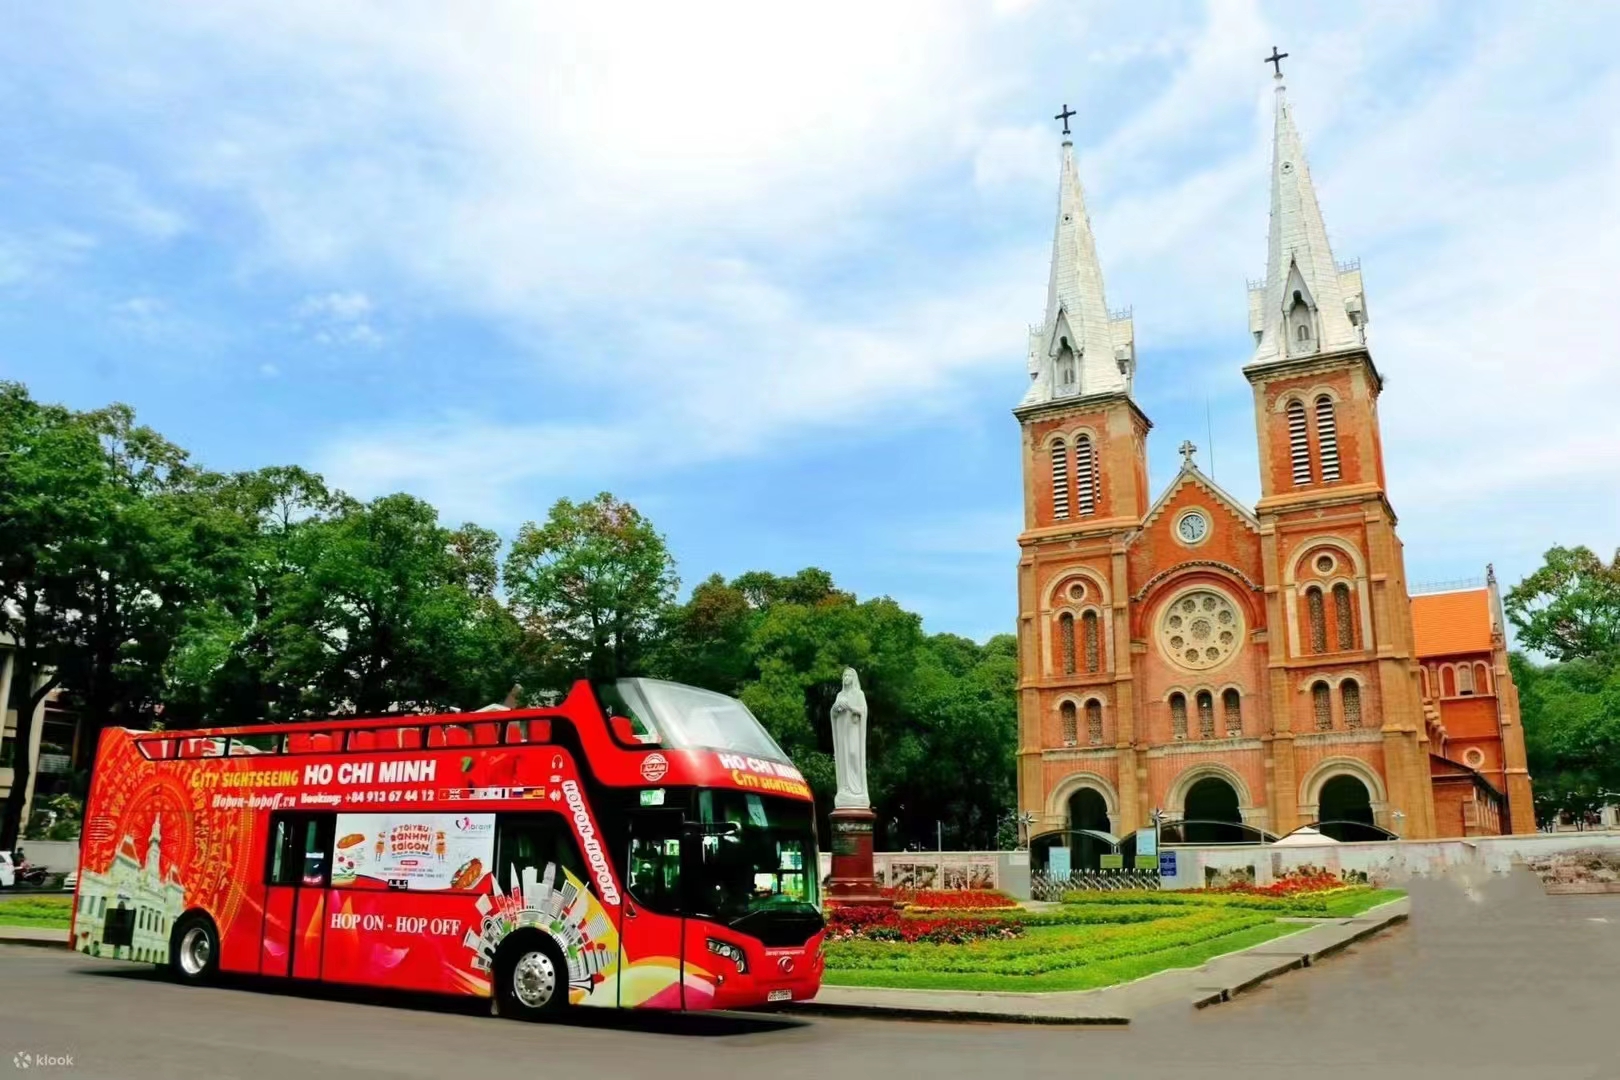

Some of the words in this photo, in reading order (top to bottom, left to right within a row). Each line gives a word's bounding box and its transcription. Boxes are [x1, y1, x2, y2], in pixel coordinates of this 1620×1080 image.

[304, 764, 333, 785] HO
[338, 762, 374, 784] CHI
[378, 760, 436, 783] MINH
[717, 753, 746, 770] HO
[747, 757, 777, 776] CHI
[222, 770, 299, 787] SIGHTSEEING
[345, 791, 364, 803] +84
[367, 791, 386, 802] 913
[388, 790, 402, 802] 67
[404, 790, 418, 802] 44
[422, 789, 434, 801] 12
[562, 780, 620, 905] HOPON-HOPOFF
[331, 913, 360, 929] HOP
[363, 914, 384, 930] ON
[396, 916, 428, 933] HOP
[430, 918, 461, 936] OFF
